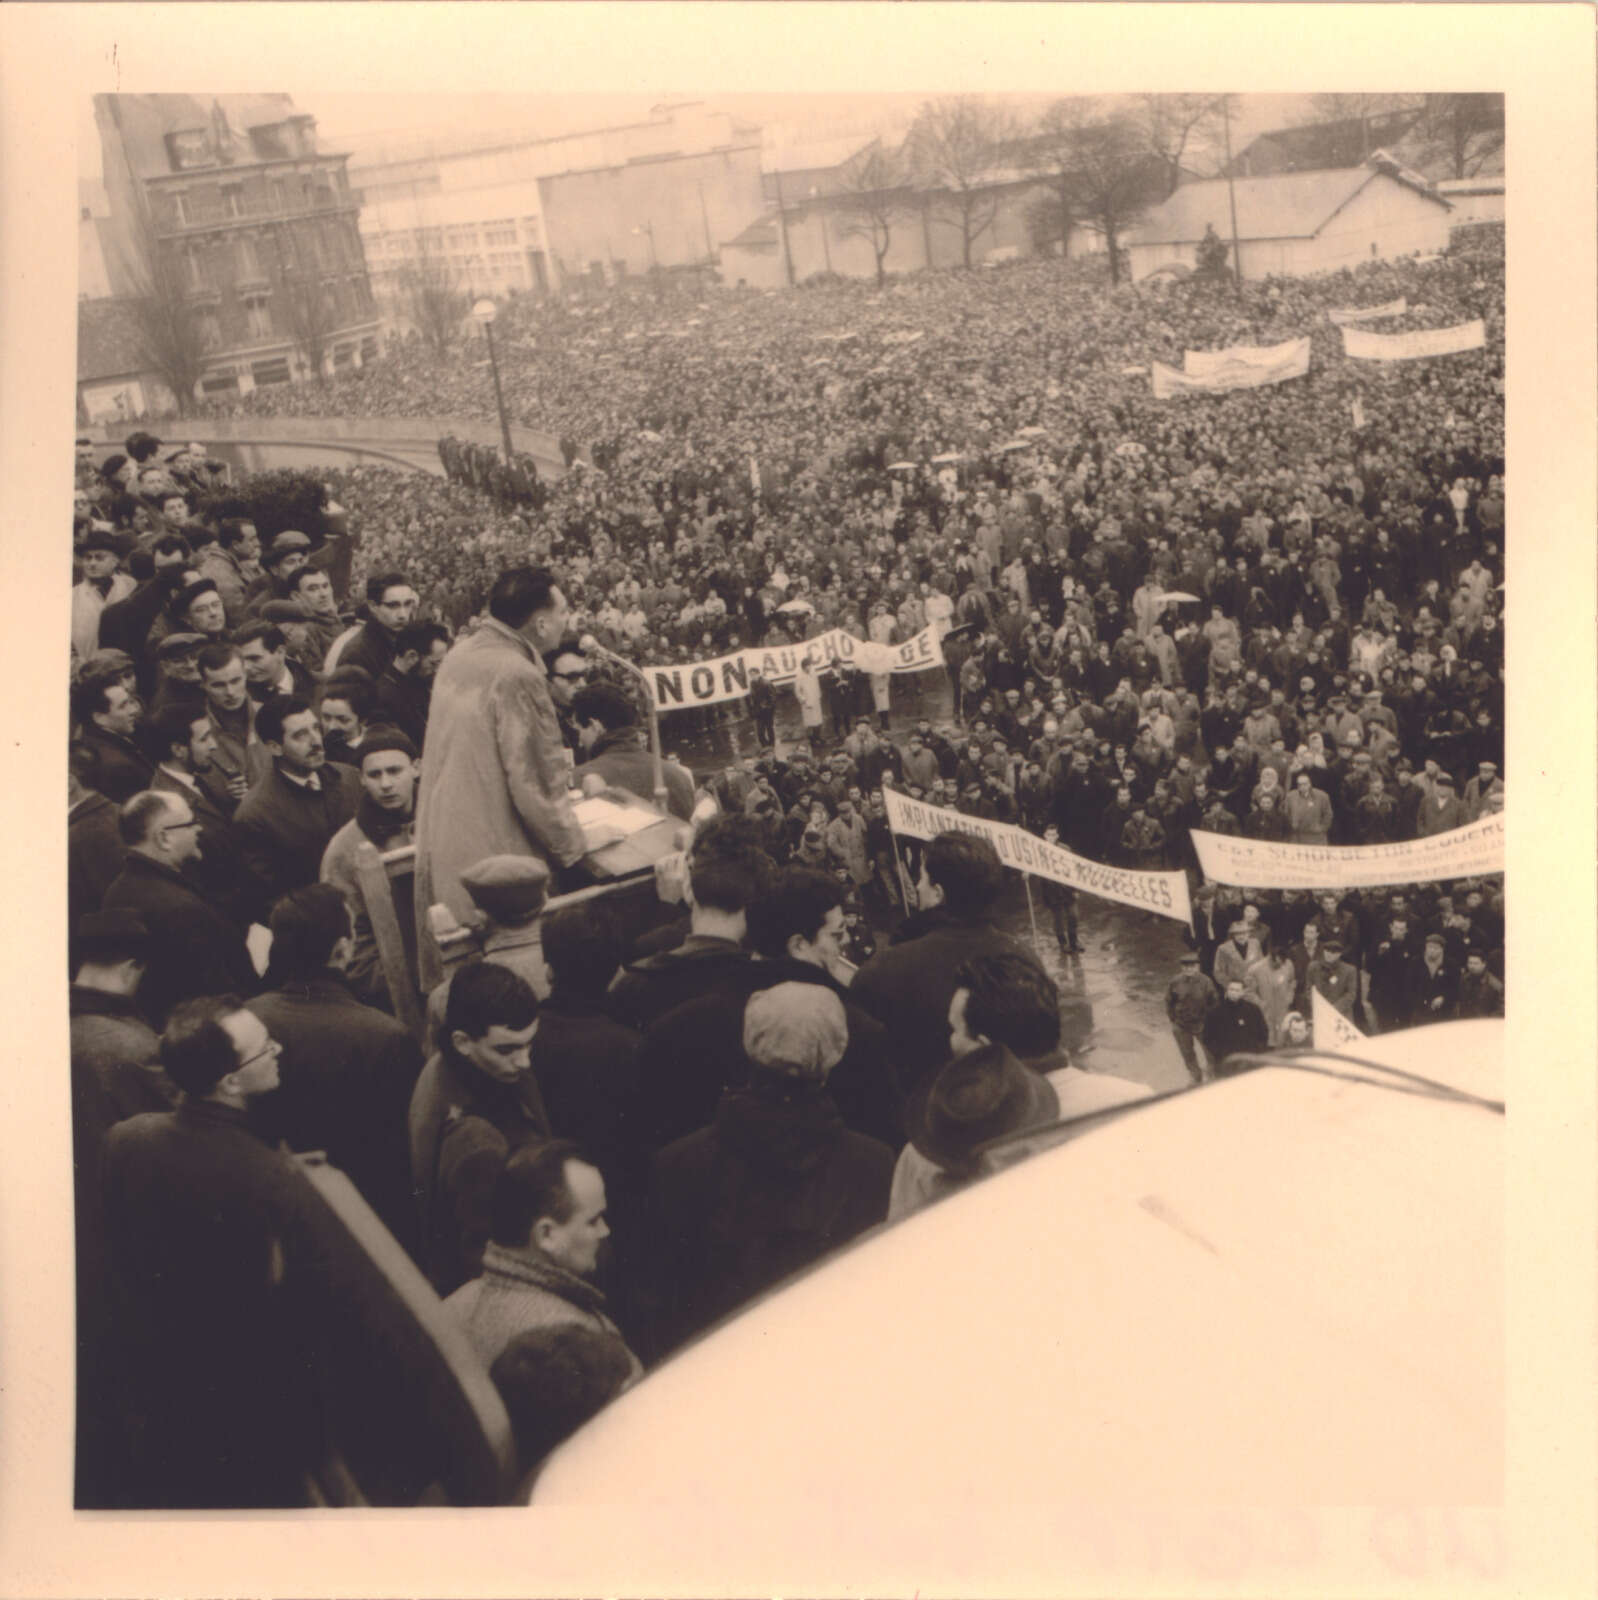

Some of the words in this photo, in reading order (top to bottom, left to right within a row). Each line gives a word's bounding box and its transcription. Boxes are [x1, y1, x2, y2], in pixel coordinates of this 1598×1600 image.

[655, 657, 748, 705] NON
[762, 651, 797, 676] AU
[805, 632, 932, 665] CHOGE
